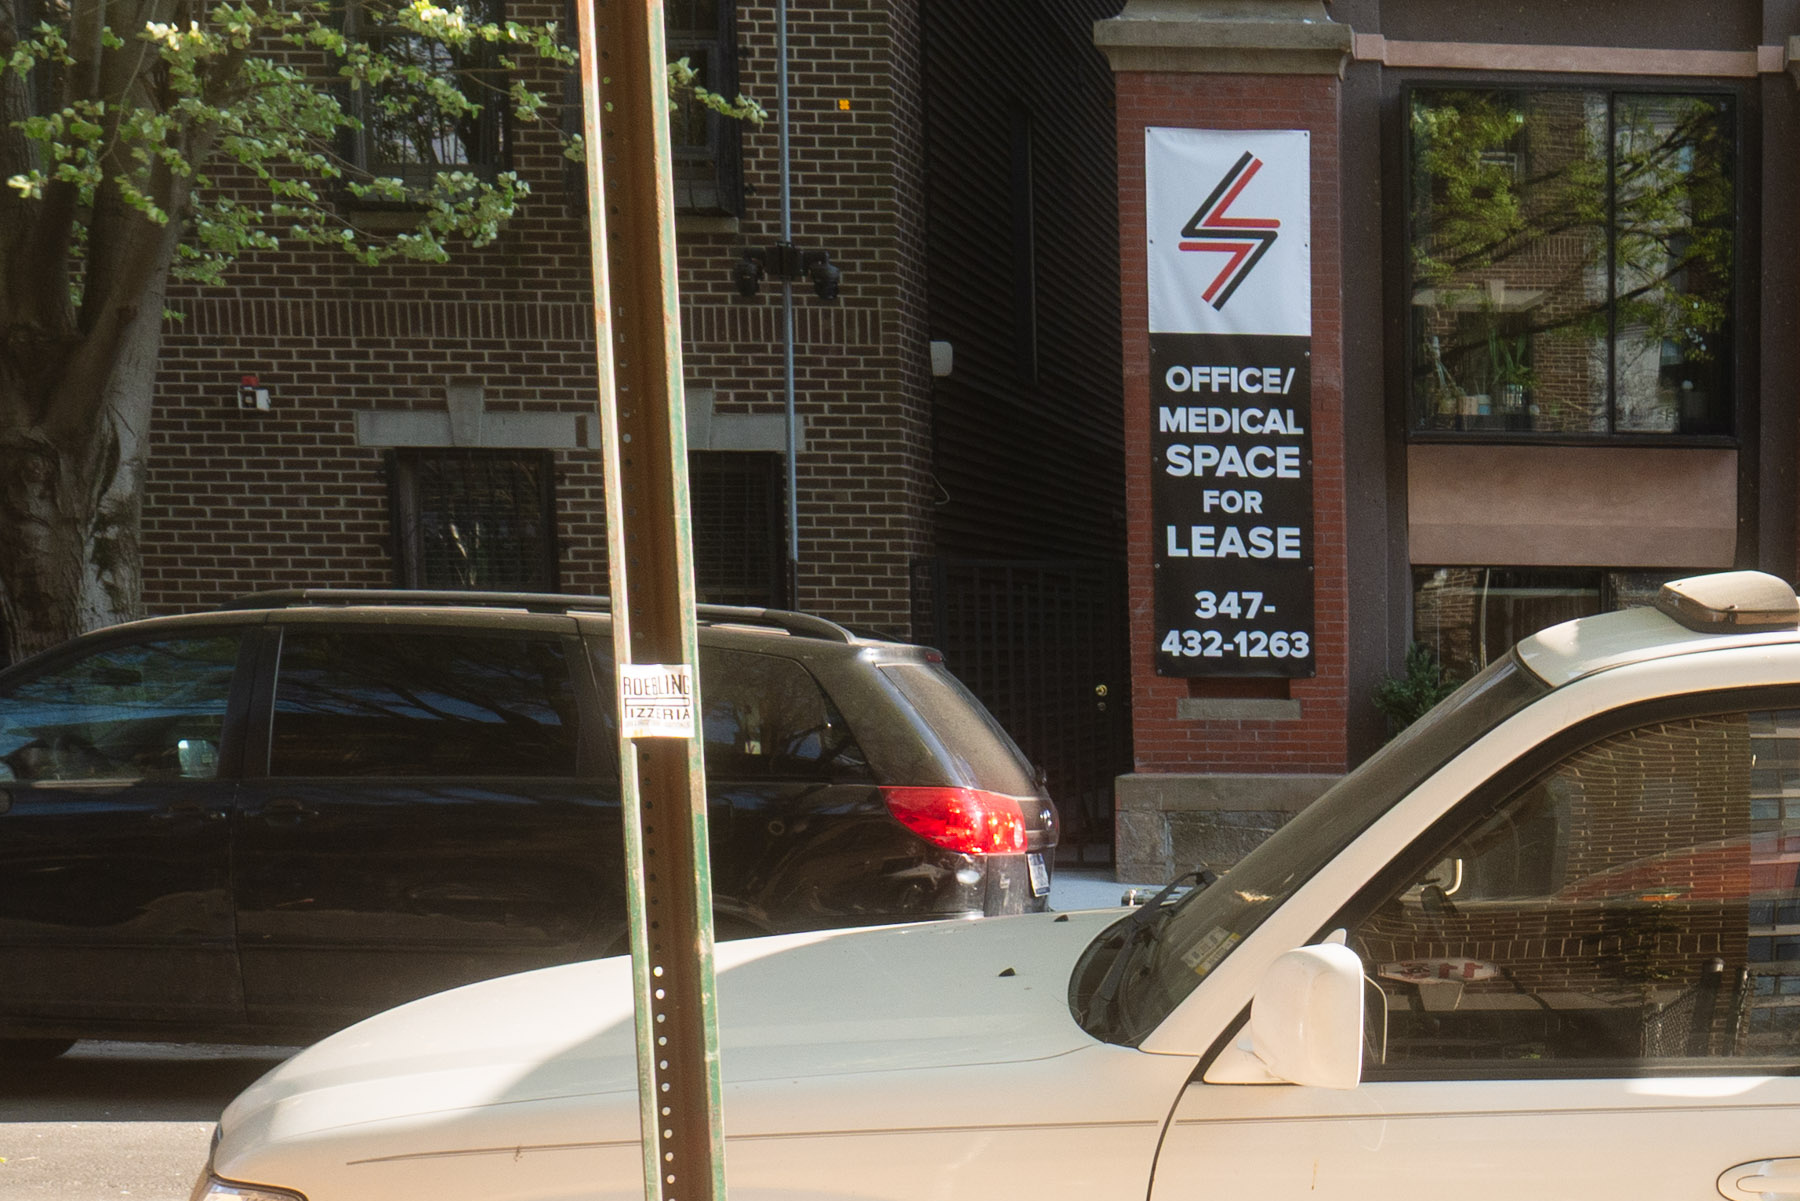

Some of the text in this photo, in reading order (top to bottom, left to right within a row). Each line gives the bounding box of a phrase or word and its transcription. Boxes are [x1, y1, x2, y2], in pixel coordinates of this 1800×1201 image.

[1165, 366, 1295, 395] OFFICE/
[1159, 407, 1304, 435] MEDICAL
[1165, 445, 1301, 479] SPACE
[1203, 490, 1263, 514] FOR
[1167, 526, 1301, 559] LEASE
[1194, 591, 1276, 619] 347-
[1161, 630, 1310, 659] 432-1263
[623, 674, 690, 695] ROEBLING
